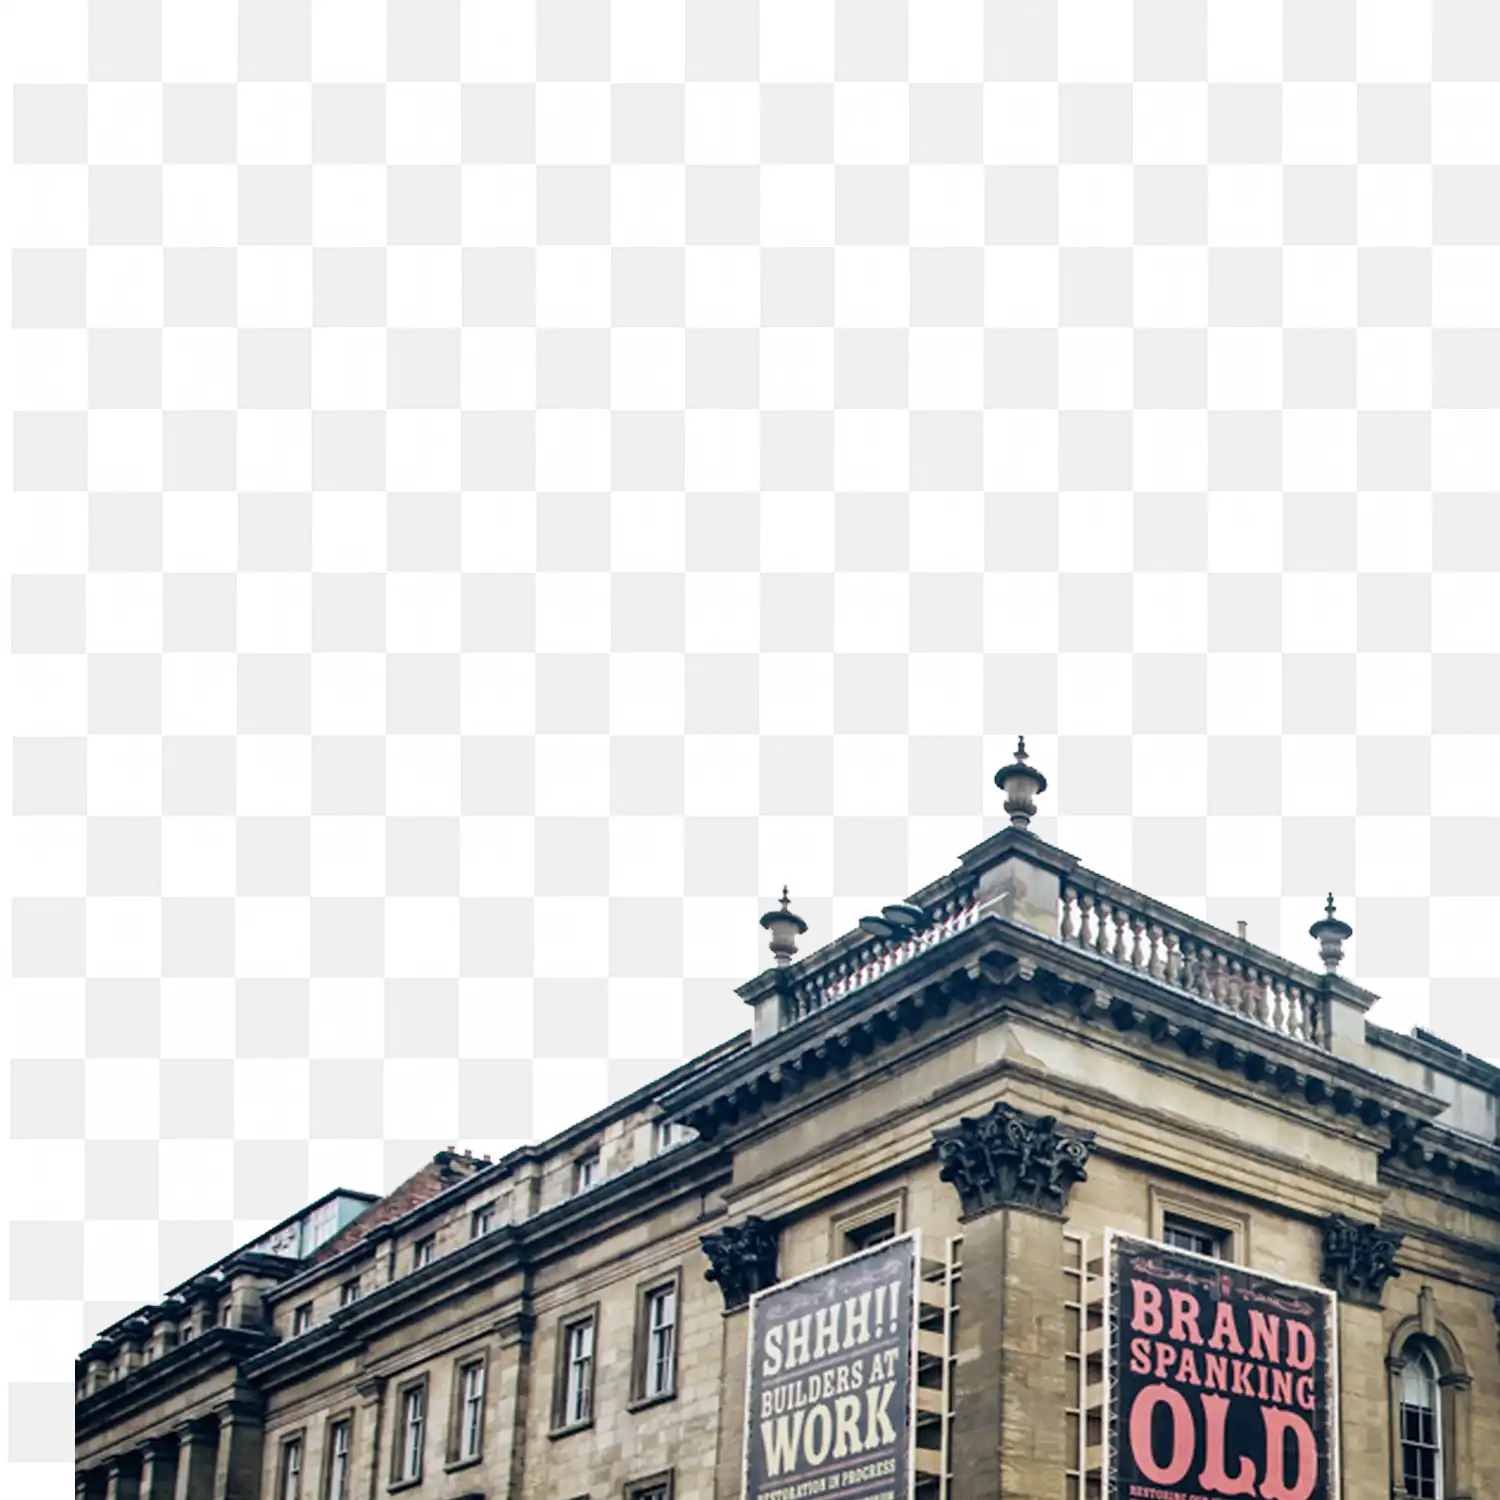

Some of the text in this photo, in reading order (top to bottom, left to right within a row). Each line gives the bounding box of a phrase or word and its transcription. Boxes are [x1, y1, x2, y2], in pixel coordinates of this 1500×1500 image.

[762, 1280, 902, 1377] SHHH!!
[1130, 1279, 1317, 1371] BRAND
[761, 1347, 899, 1418] BUILDERS AT
[1130, 1337, 1316, 1411] SPANKING
[760, 1381, 898, 1477] WORK
[827, 1474, 840, 1490] IN
[842, 1458, 896, 1486] PROGRESS
